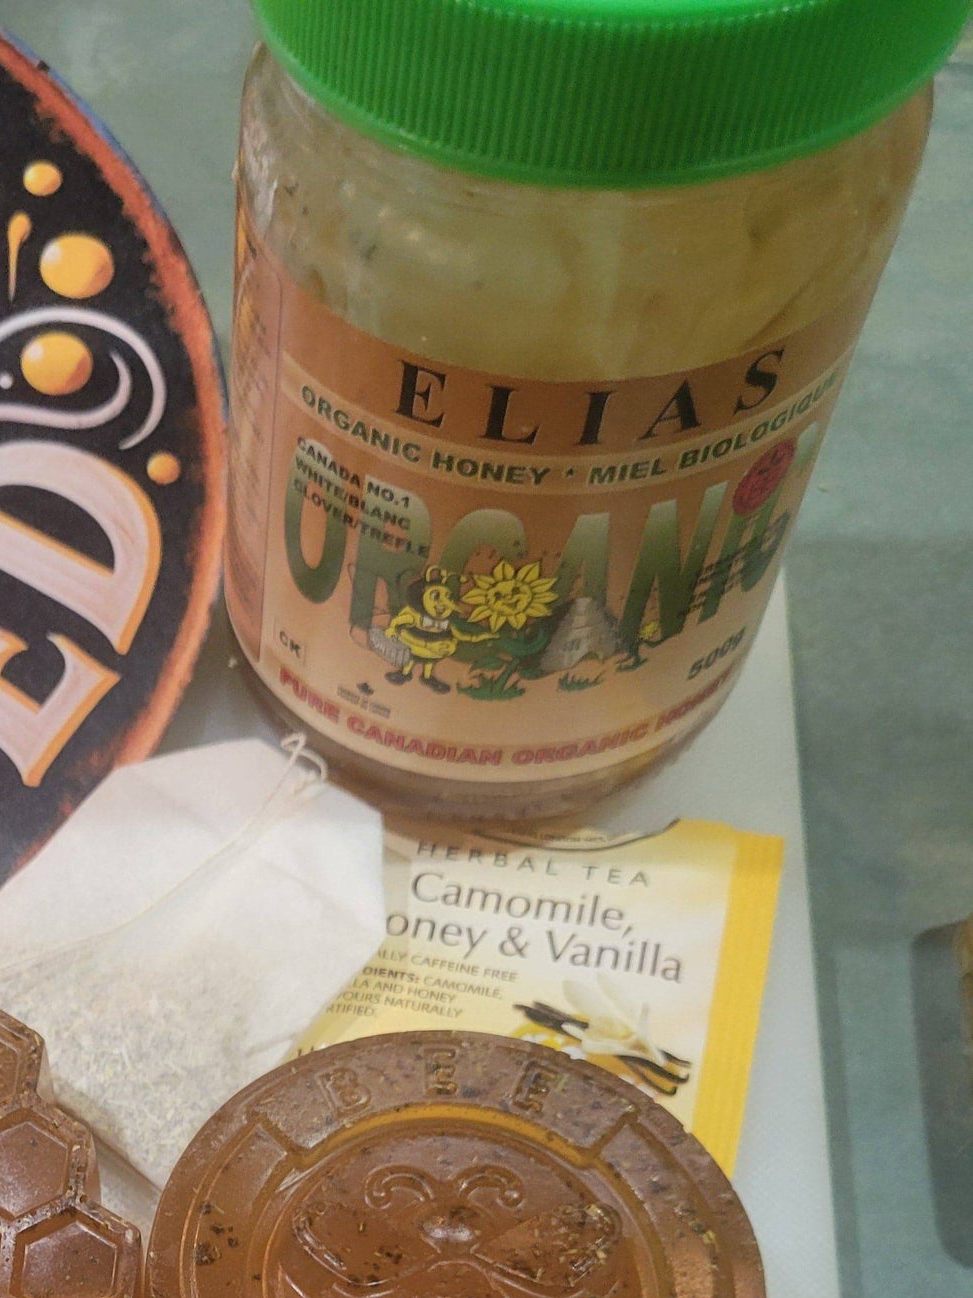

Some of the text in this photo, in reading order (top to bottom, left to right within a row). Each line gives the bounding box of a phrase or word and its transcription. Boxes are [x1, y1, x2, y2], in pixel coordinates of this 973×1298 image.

[300, 371, 837, 486] ORGANIC HONEY MIEL BIOLOGIQUE
[394, 346, 786, 446] ELIAS
[295, 454, 411, 530] WHITE/BLANC
[297, 436, 411, 510] CANADA NO.1
[279, 665, 340, 724] PURE
[346, 715, 504, 766] CANADIAN
[510, 720, 649, 765] ORGANIC
[416, 840, 650, 888] HERBAL TEA
[411, 871, 633, 938] Camomile,
[361, 966, 420, 985] DIENTS:
[385, 912, 684, 984] oney & Vanilla
[410, 951, 480, 977] CAFFEINE
[482, 967, 519, 983] FREE
[374, 980, 404, 994] AND
[406, 985, 457, 1004] HONEY
[383, 996, 463, 1019] NATURALLY
[318, 1045, 558, 1117] BEE
